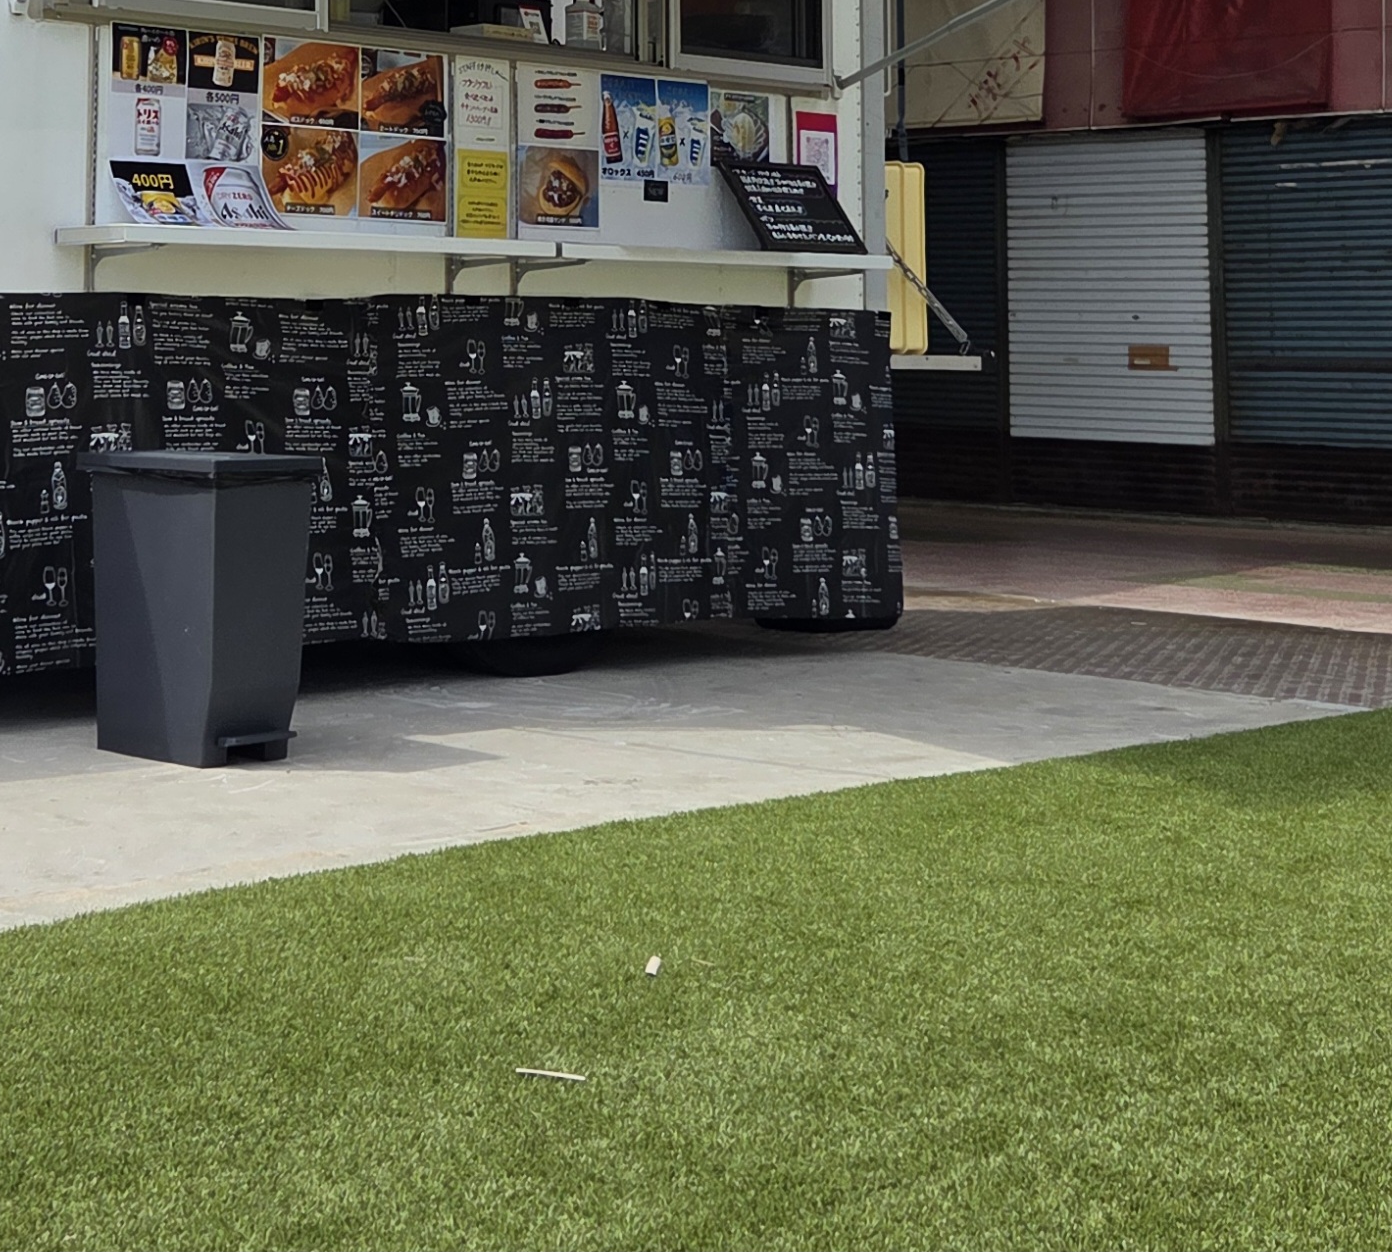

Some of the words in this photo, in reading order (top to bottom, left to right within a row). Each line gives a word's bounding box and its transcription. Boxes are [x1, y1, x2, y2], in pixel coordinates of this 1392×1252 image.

[206, 91, 240, 105] 各500円
[132, 173, 175, 190] 400円
[221, 202, 269, 220] Asahi
